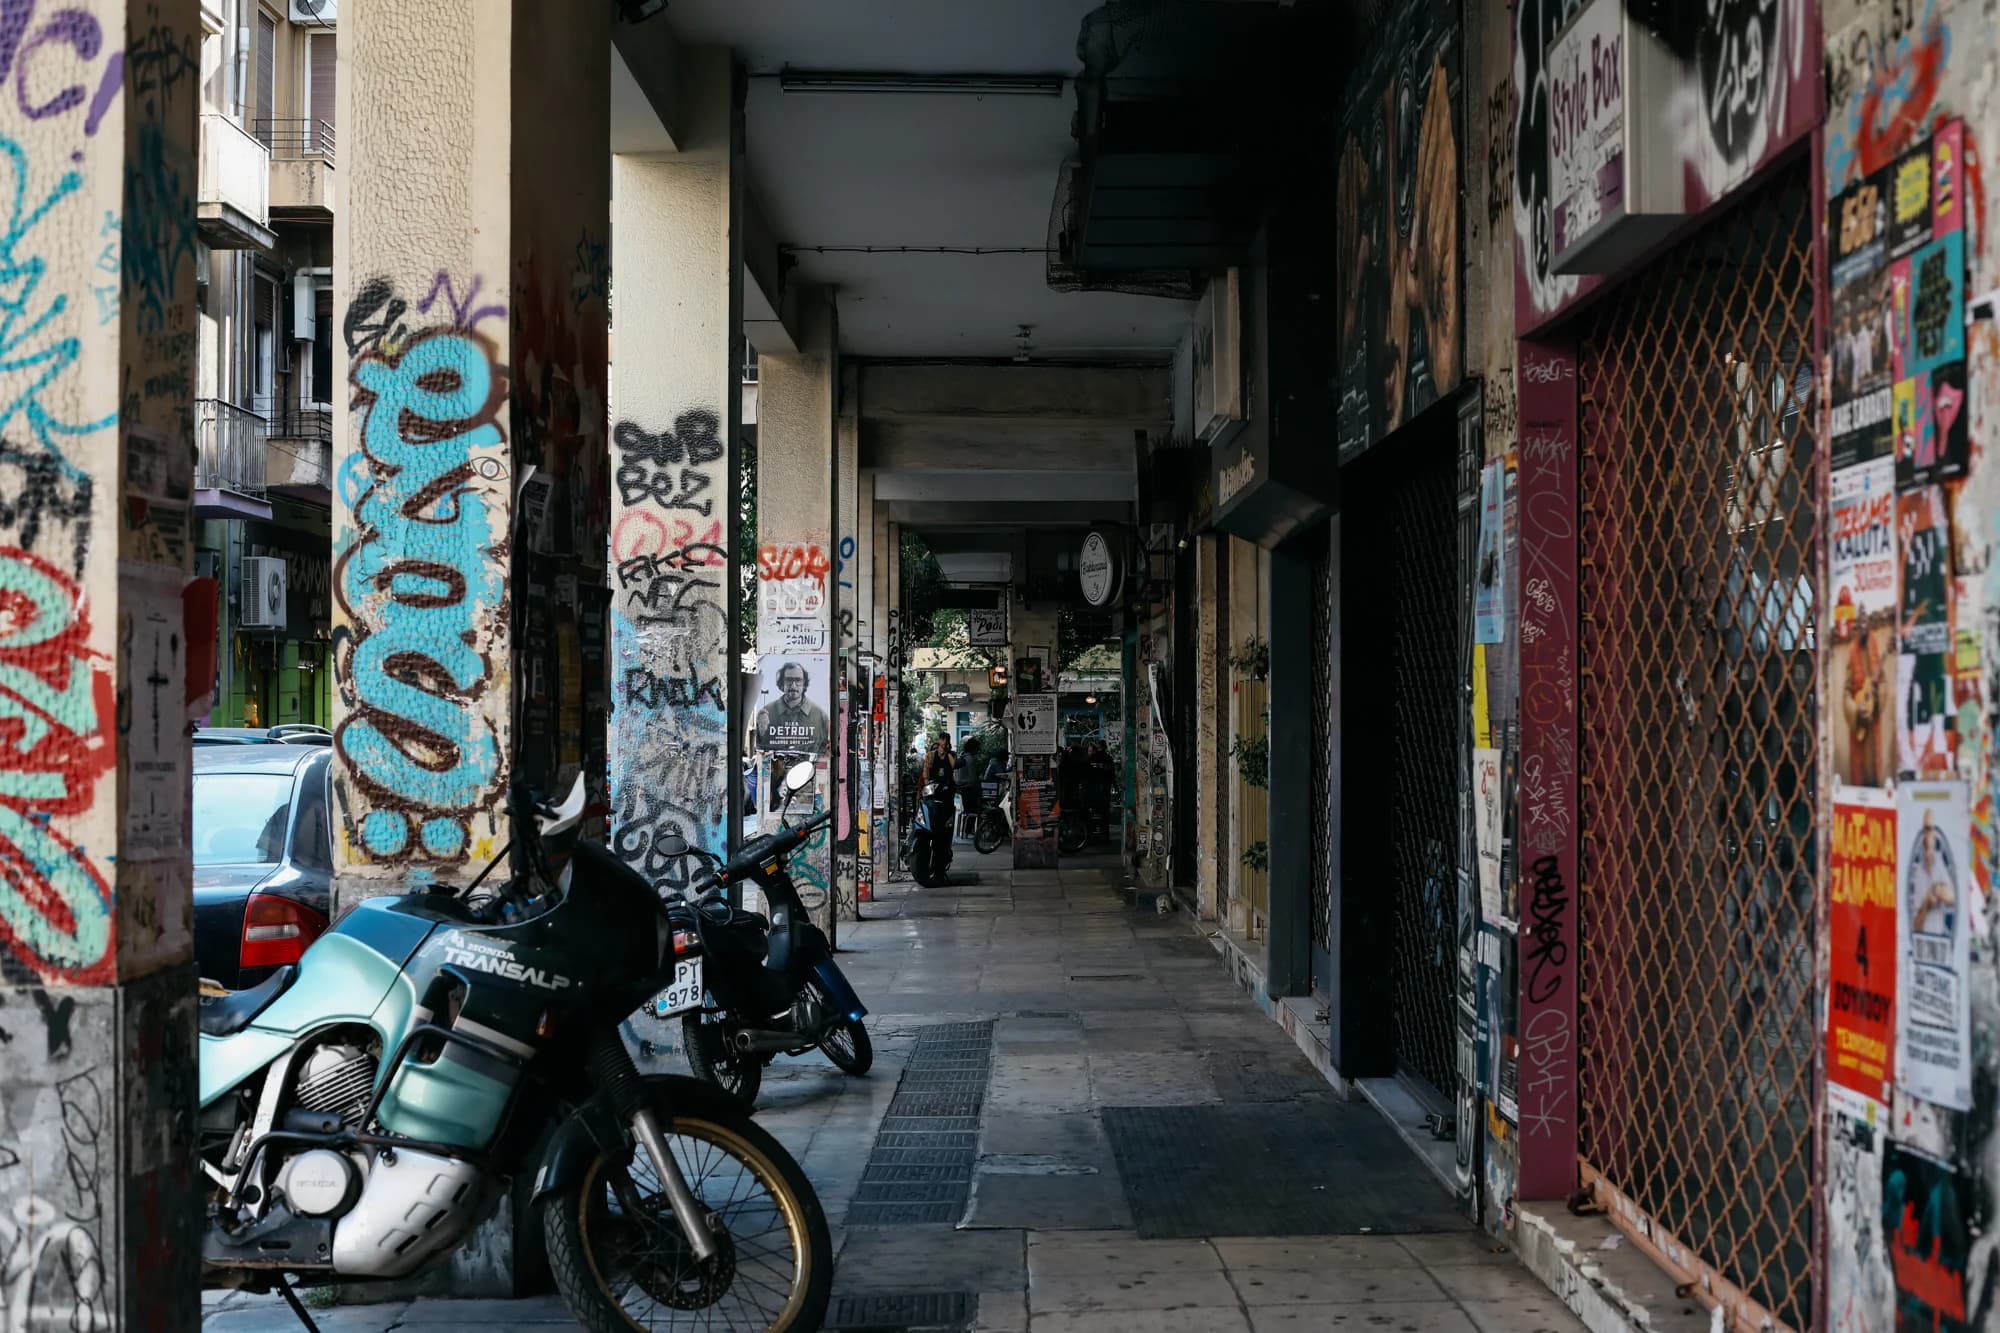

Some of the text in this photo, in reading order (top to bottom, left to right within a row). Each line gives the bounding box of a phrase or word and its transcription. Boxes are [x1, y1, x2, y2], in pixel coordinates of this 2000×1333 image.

[1552, 53, 1588, 158] Style
[1591, 33, 1621, 121] Box
[1834, 522, 1893, 562] KALUTA
[769, 726, 816, 736] DETROIT
[443, 946, 571, 991] TRANSALP
[467, 943, 516, 961] HONDA
[1856, 925, 1868, 977] 4
[668, 985, 699, 1007] 978
